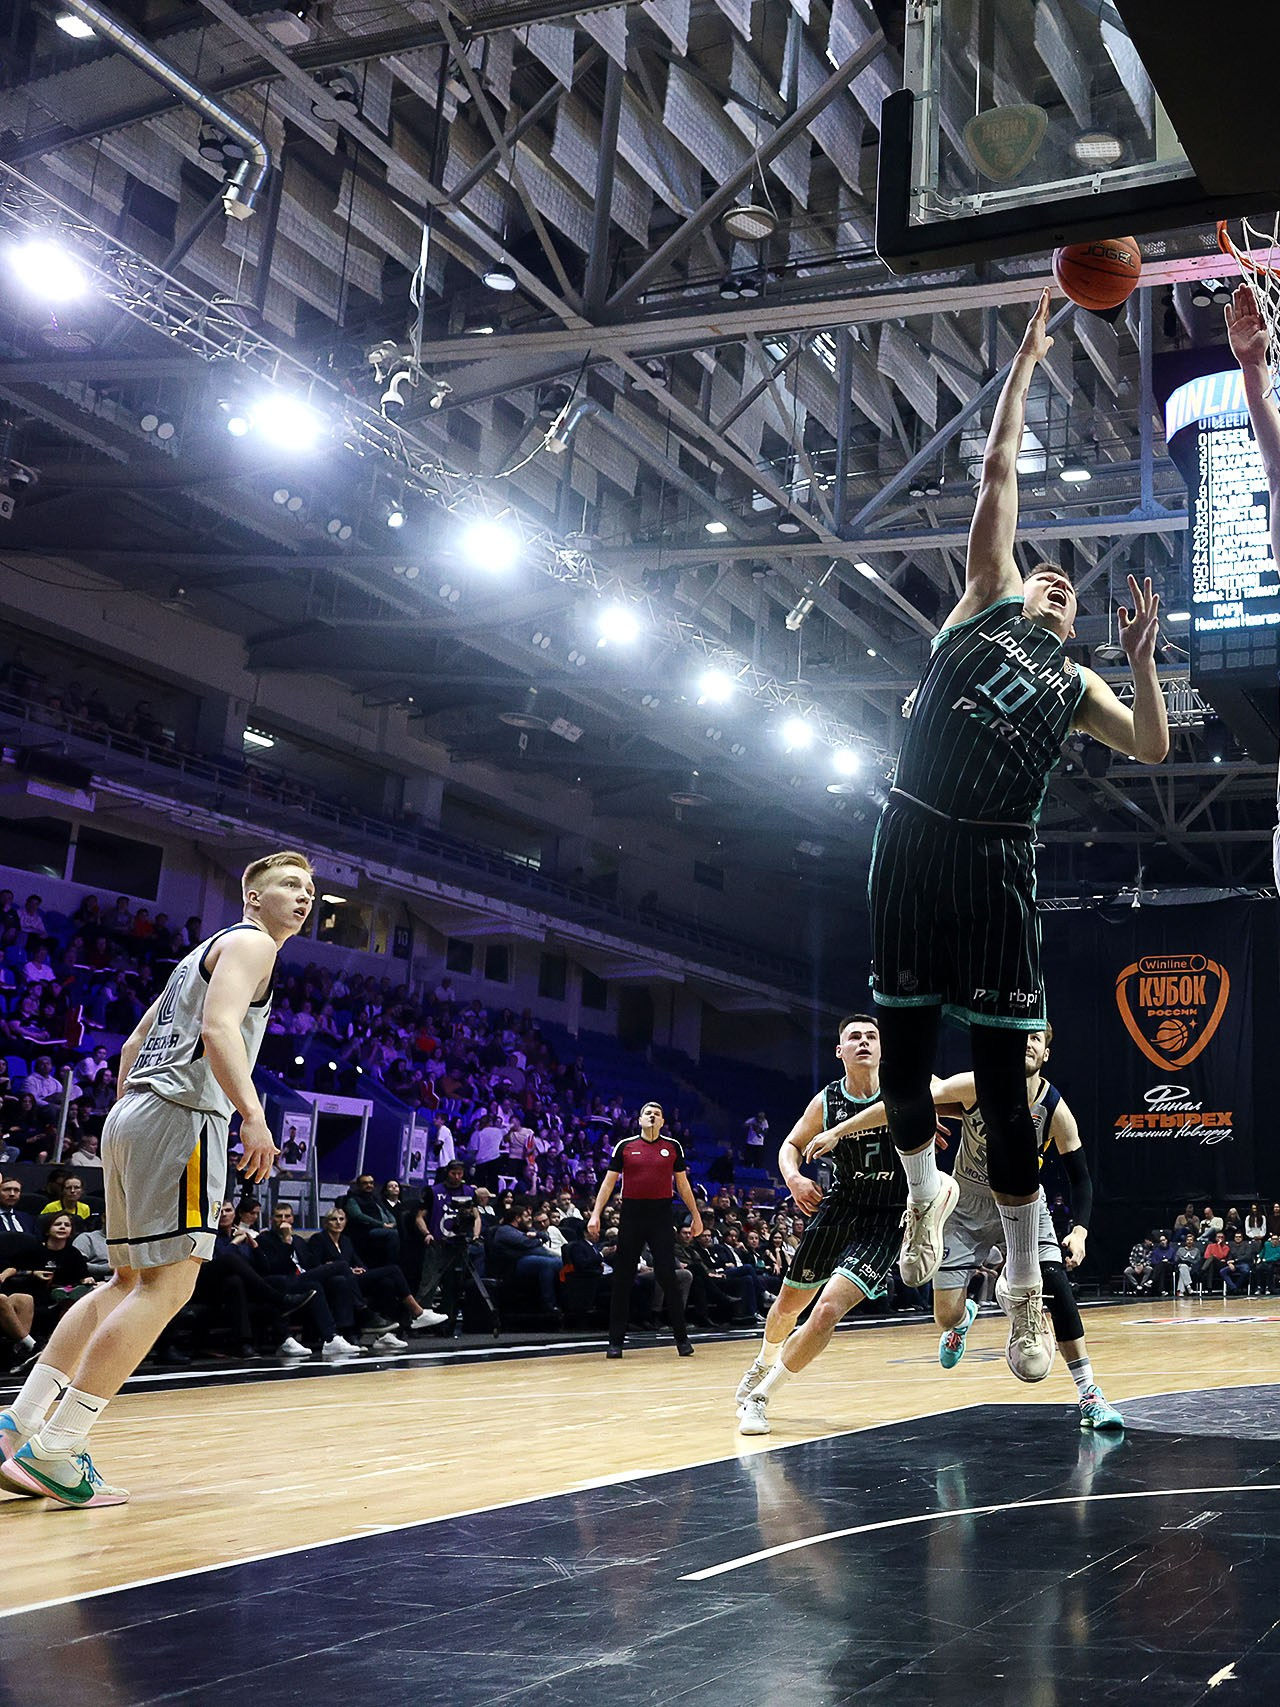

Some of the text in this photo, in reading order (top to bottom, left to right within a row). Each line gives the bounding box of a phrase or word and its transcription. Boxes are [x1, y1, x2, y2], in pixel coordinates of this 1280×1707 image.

[1193, 538, 1208, 551] 42
[1192, 551, 1208, 565] 44
[1193, 565, 1209, 579] 50
[1193, 578, 1210, 592] 55
[975, 662, 1037, 714] 10
[1145, 959, 1188, 970] Winline
[1139, 975, 1207, 1007] КУБОК
[1147, 1008, 1198, 1017] РОССИИ
[1143, 1085, 1203, 1112] Финал
[1115, 1119, 1234, 1145] Нижний Новгород
[865, 1142, 880, 1167] 7
[852, 1171, 895, 1181] PARI
